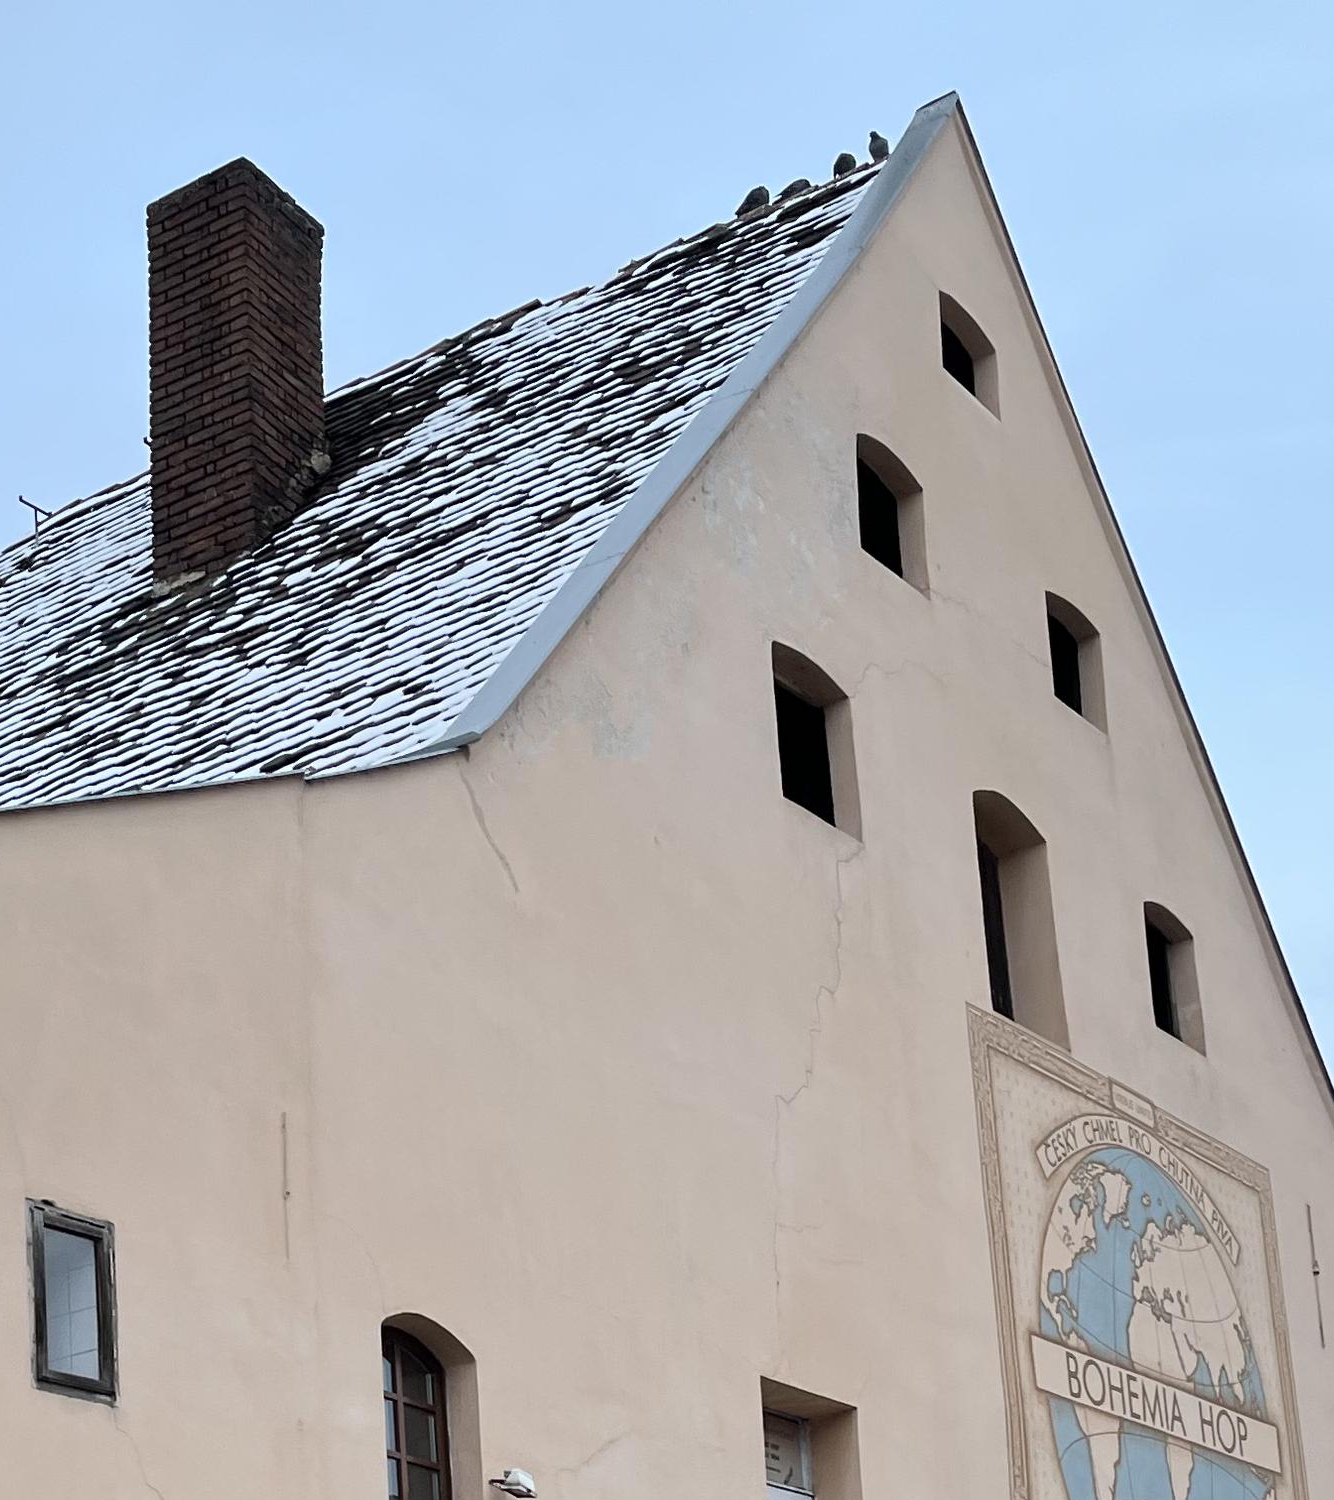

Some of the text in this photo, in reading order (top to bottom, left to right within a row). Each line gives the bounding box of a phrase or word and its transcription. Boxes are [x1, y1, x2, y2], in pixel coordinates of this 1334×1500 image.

[1083, 1119, 1123, 1144] CHMEL
[1128, 1124, 1151, 1155] PRO
[1211, 1209, 1233, 1257] PIVA
[1066, 1351, 1248, 1457] BOHEMIA HOP
